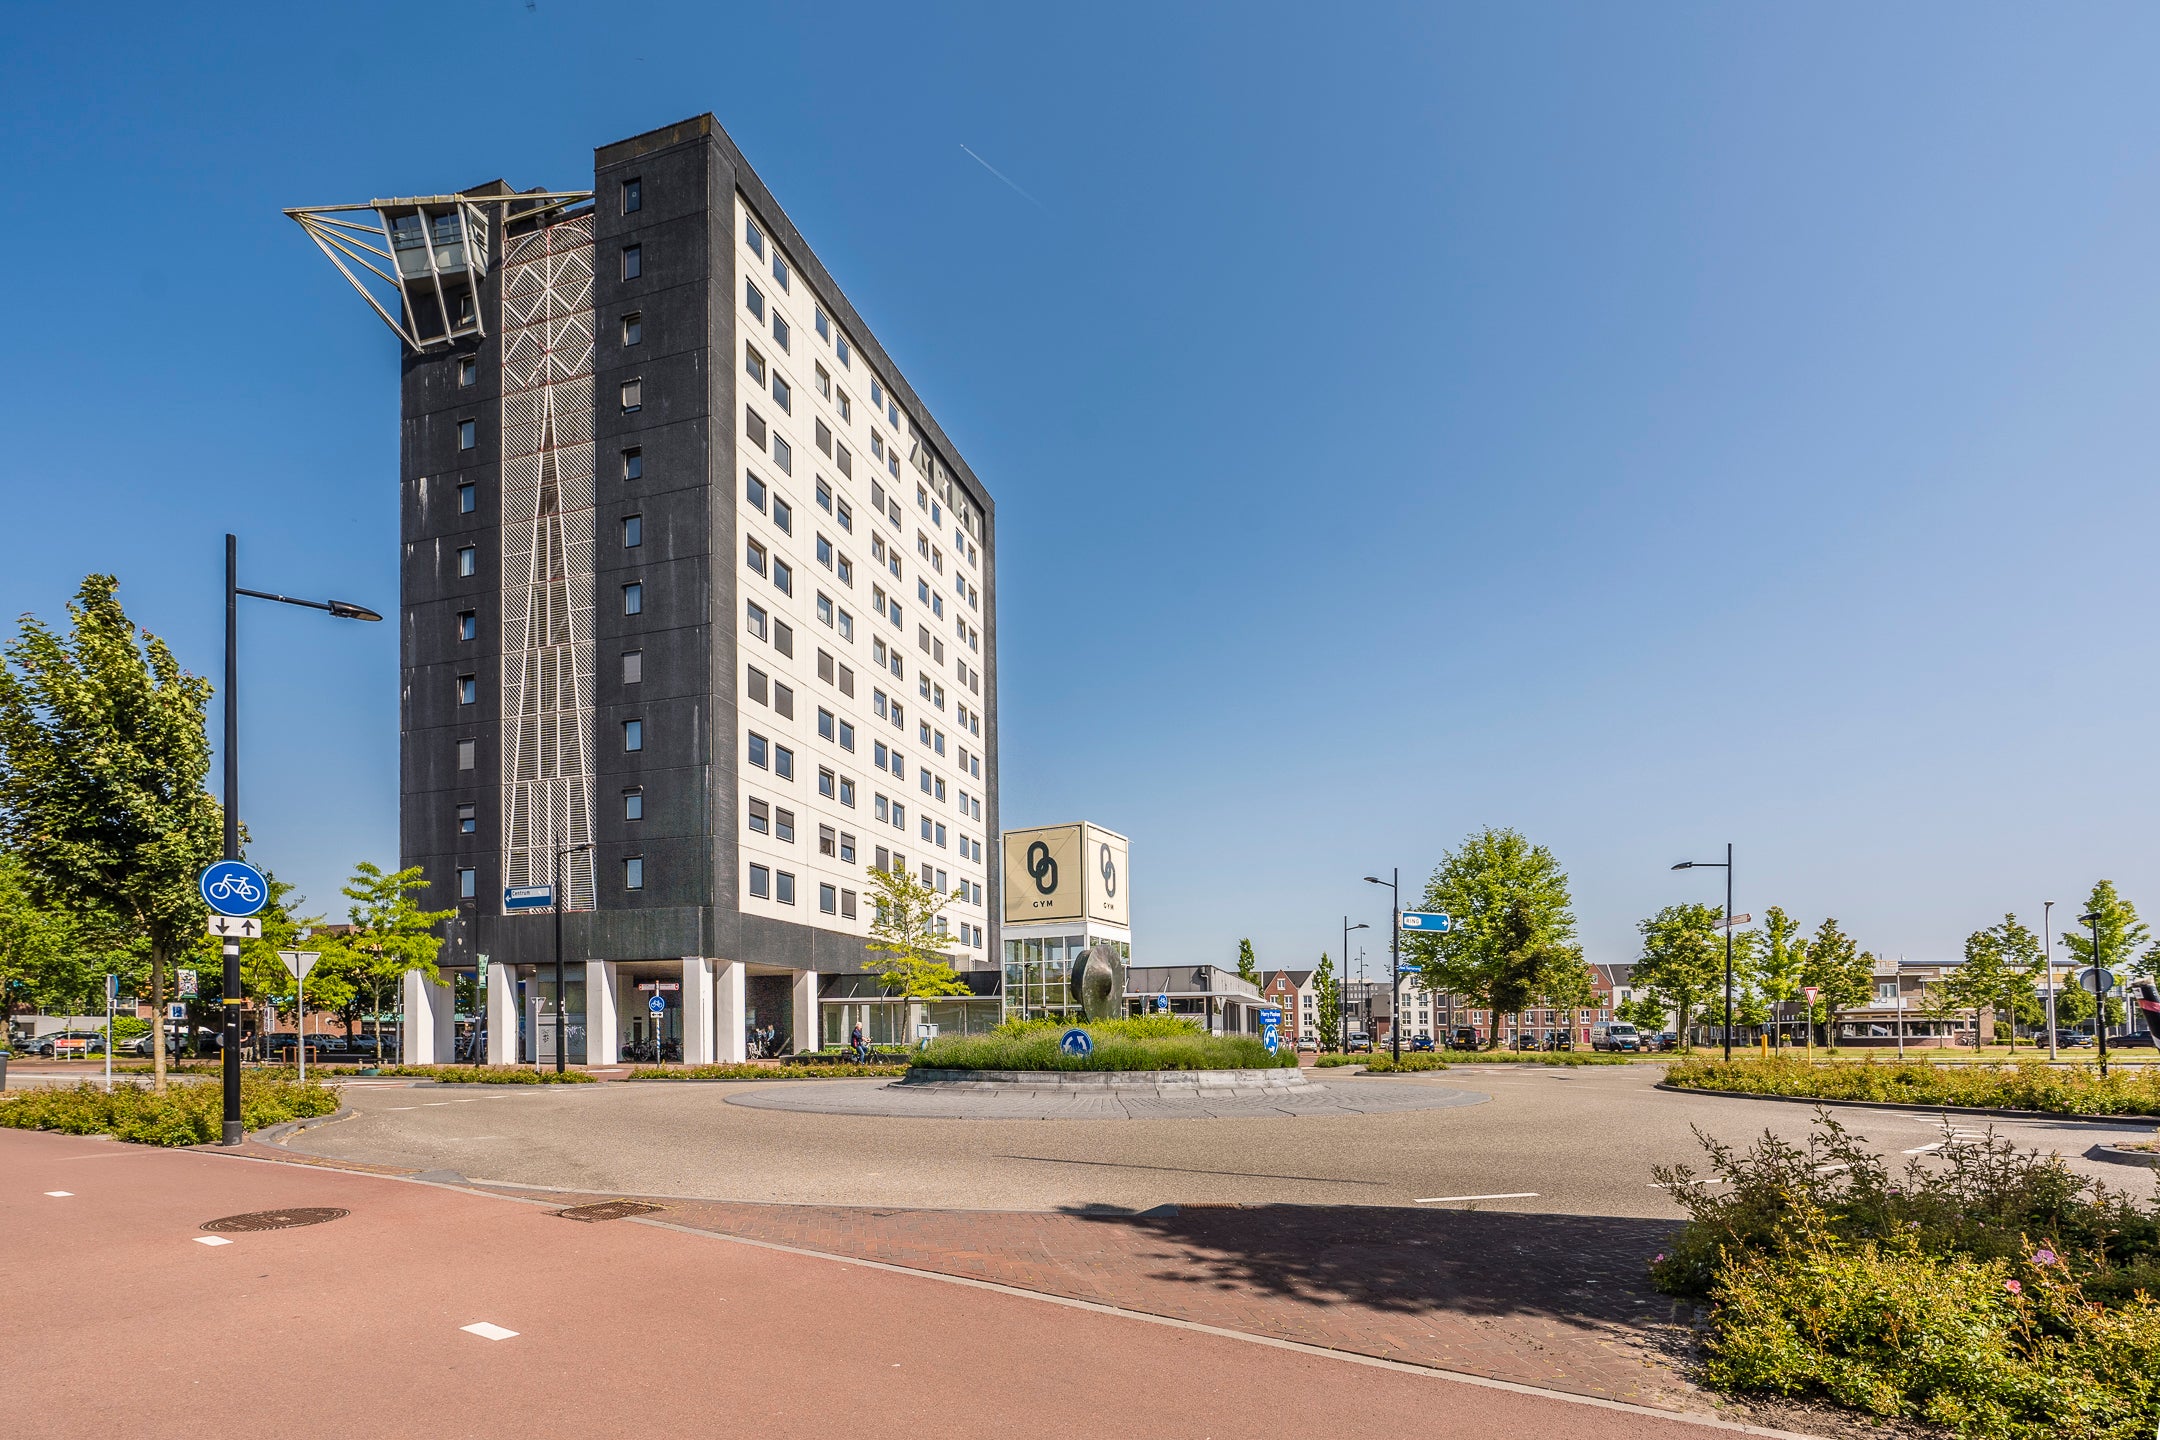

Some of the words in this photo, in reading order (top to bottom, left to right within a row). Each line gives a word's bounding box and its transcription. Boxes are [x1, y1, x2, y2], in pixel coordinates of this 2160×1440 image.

[1032, 900, 1053, 908] GYM
[1103, 902, 1114, 910] GYM
[1405, 917, 1421, 925] RING
